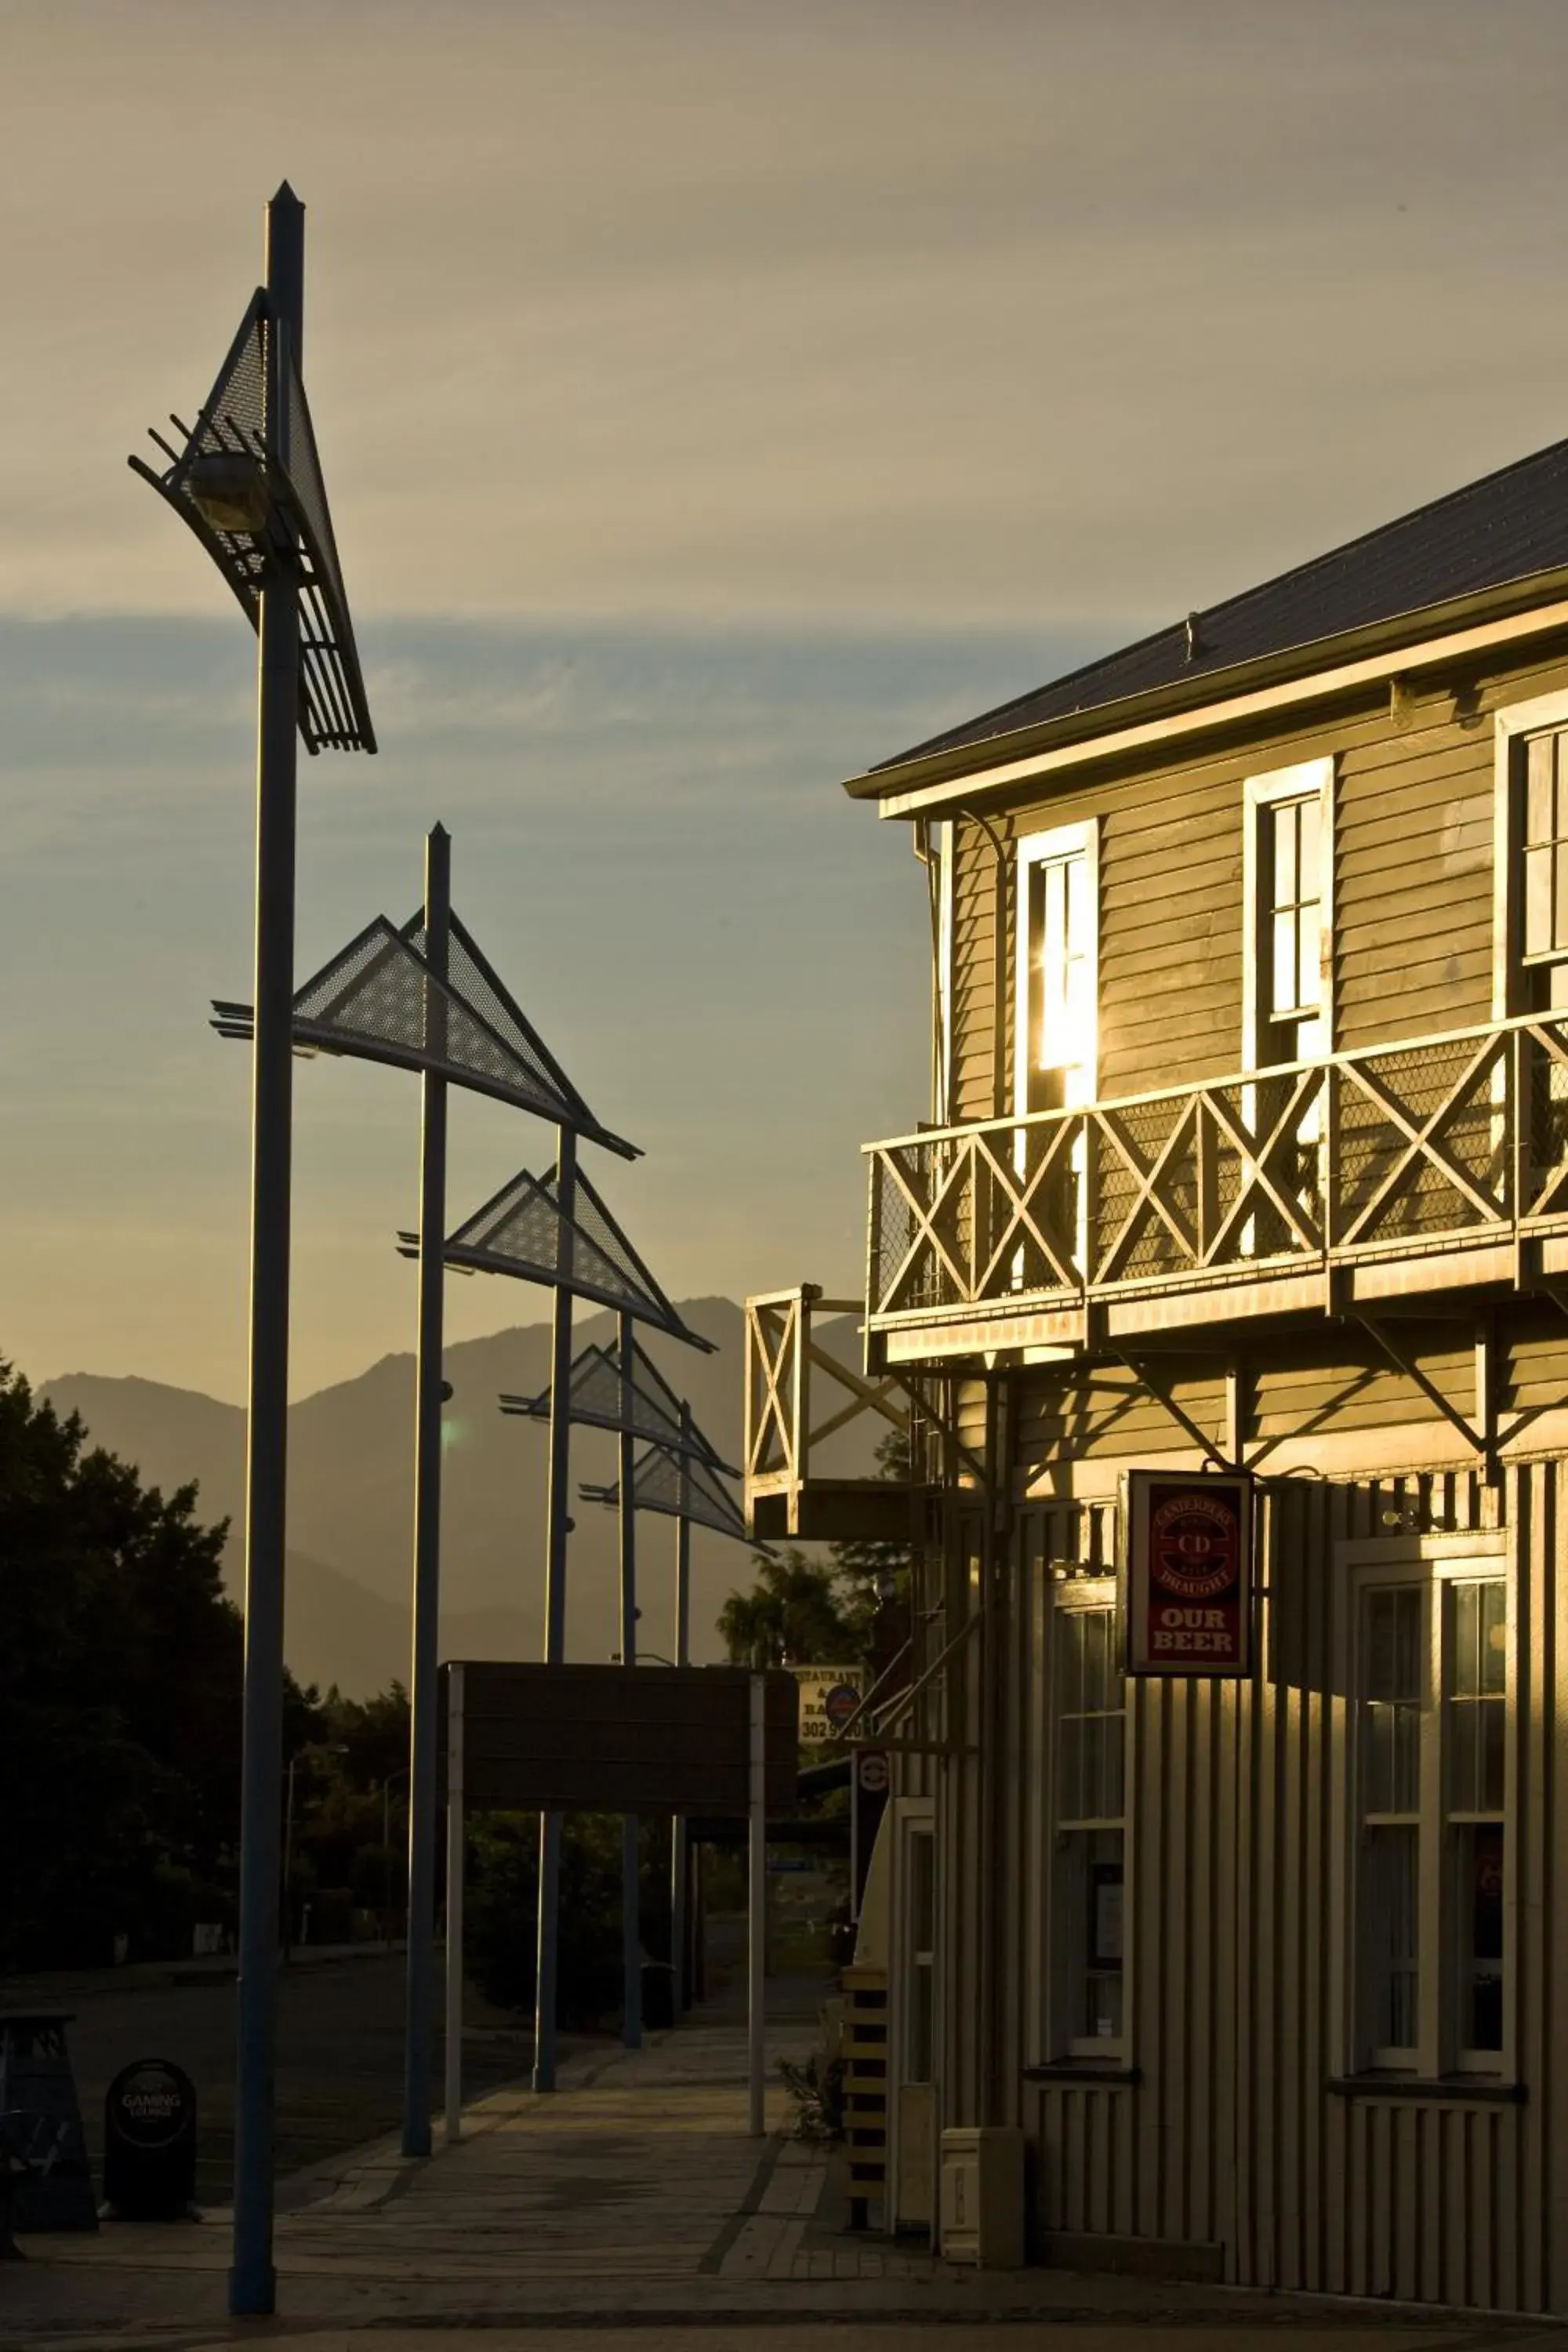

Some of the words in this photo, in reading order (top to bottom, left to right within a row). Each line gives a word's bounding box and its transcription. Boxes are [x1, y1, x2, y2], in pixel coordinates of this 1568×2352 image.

[1178, 1535, 1211, 1553] CD
[1160, 1569, 1229, 1595] DRAUGHT
[1160, 1608, 1226, 1628] OUR
[1152, 1630, 1233, 1652] BEER
[804, 1704, 826, 1715] BA
[122, 2092, 182, 2108] GAMING
